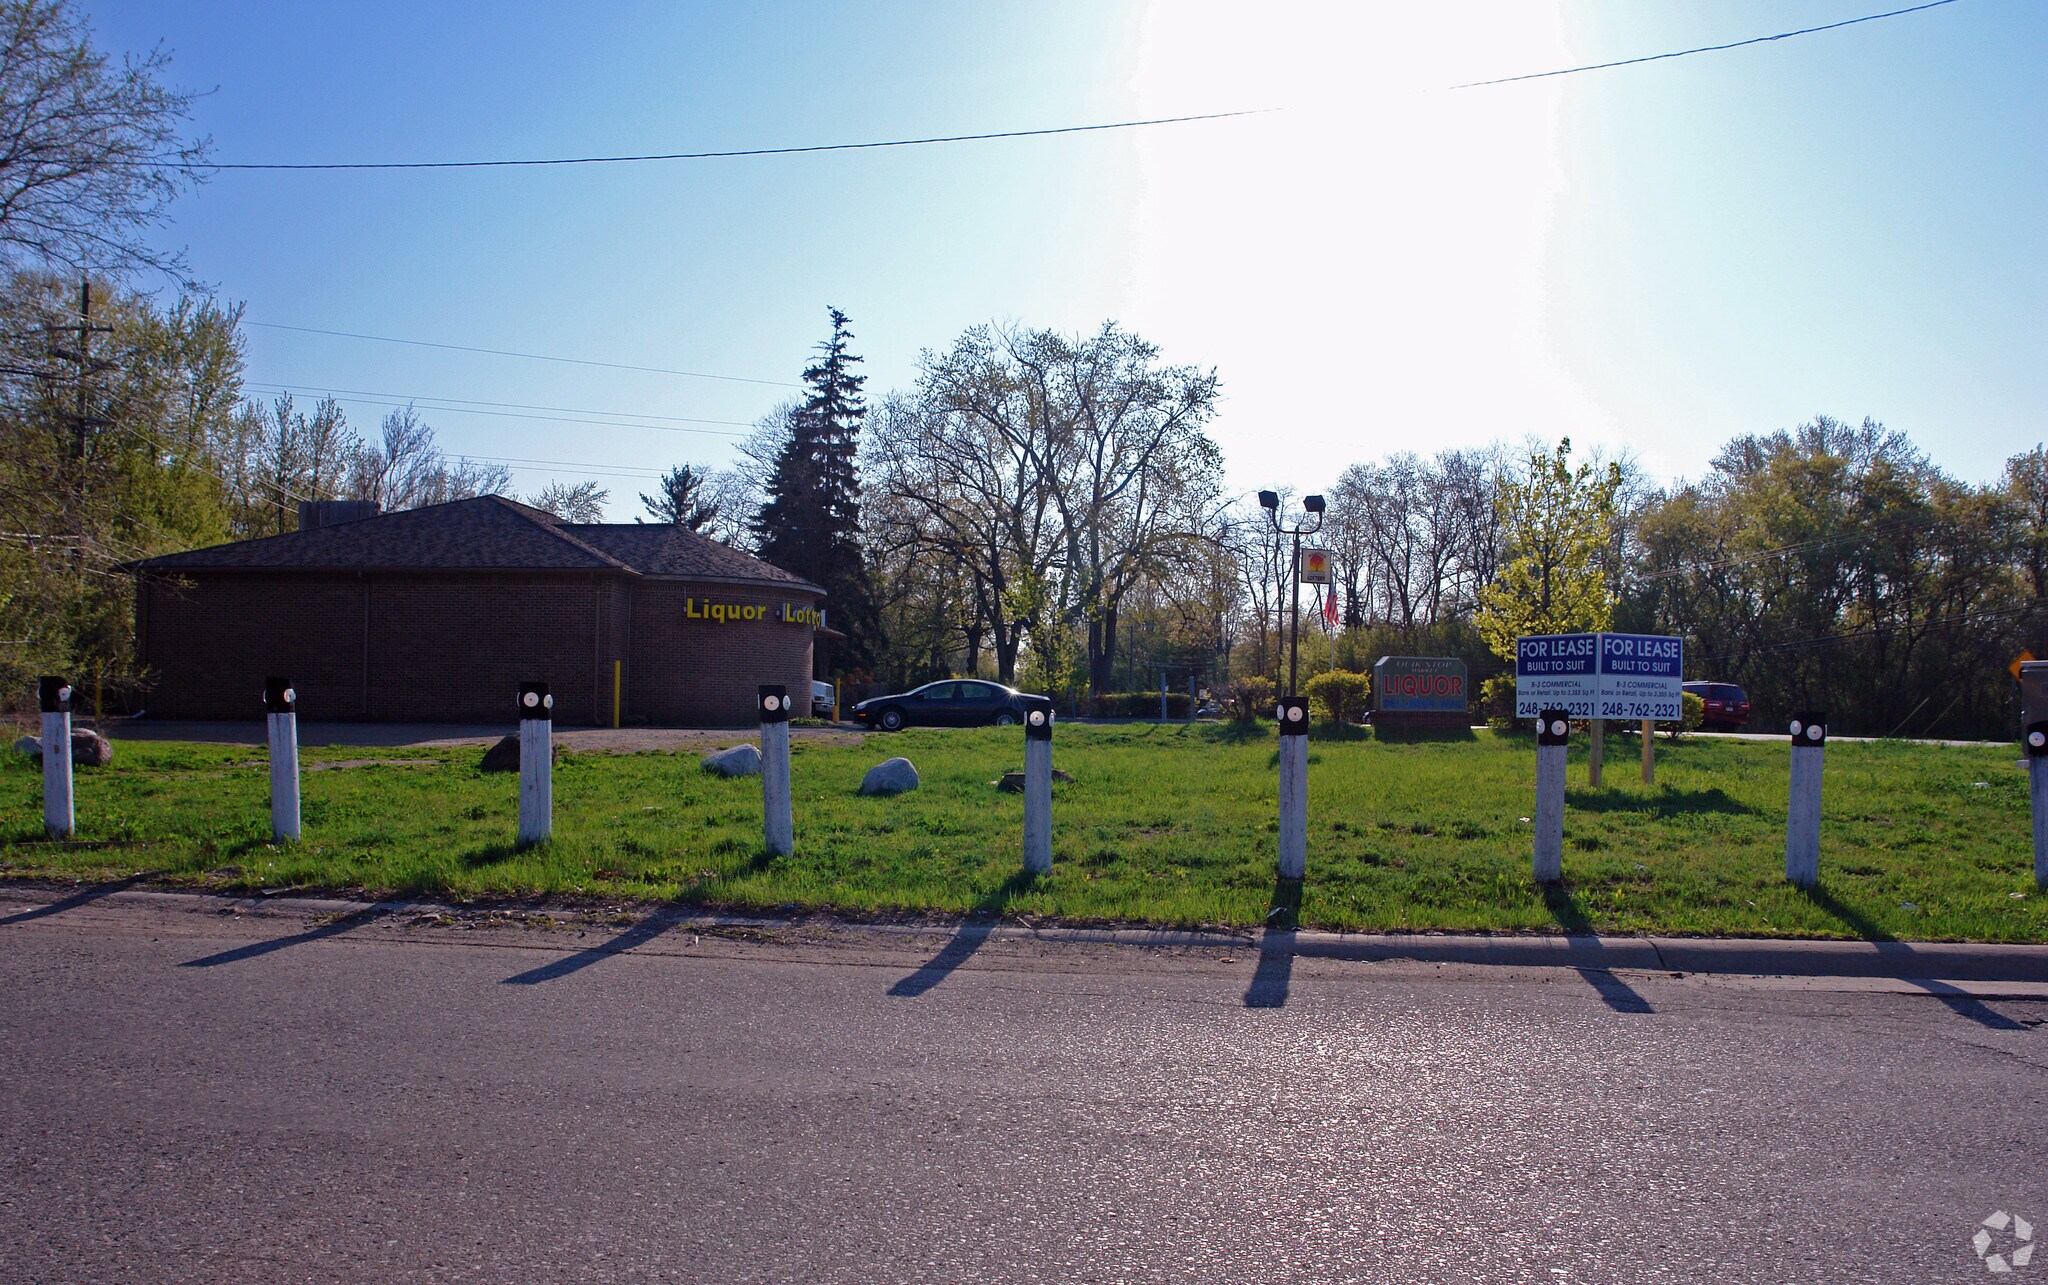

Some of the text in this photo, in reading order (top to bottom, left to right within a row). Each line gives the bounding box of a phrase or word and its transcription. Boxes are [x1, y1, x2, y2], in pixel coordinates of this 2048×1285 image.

[687, 598, 822, 626] Liquor Lotto
[1520, 639, 1594, 657] FOR LEASE
[1604, 638, 1679, 658] FOR LEASE
[1527, 660, 1585, 671] BUILT TO SUIT
[1611, 660, 1671, 673] BUILT TO SUIT
[1384, 674, 1464, 698] LIQUOR
[1542, 680, 1581, 688] COMMERCIAL
[1627, 681, 1668, 689] COMMERCIAL
[1602, 702, 1680, 717] 248-762-2321
